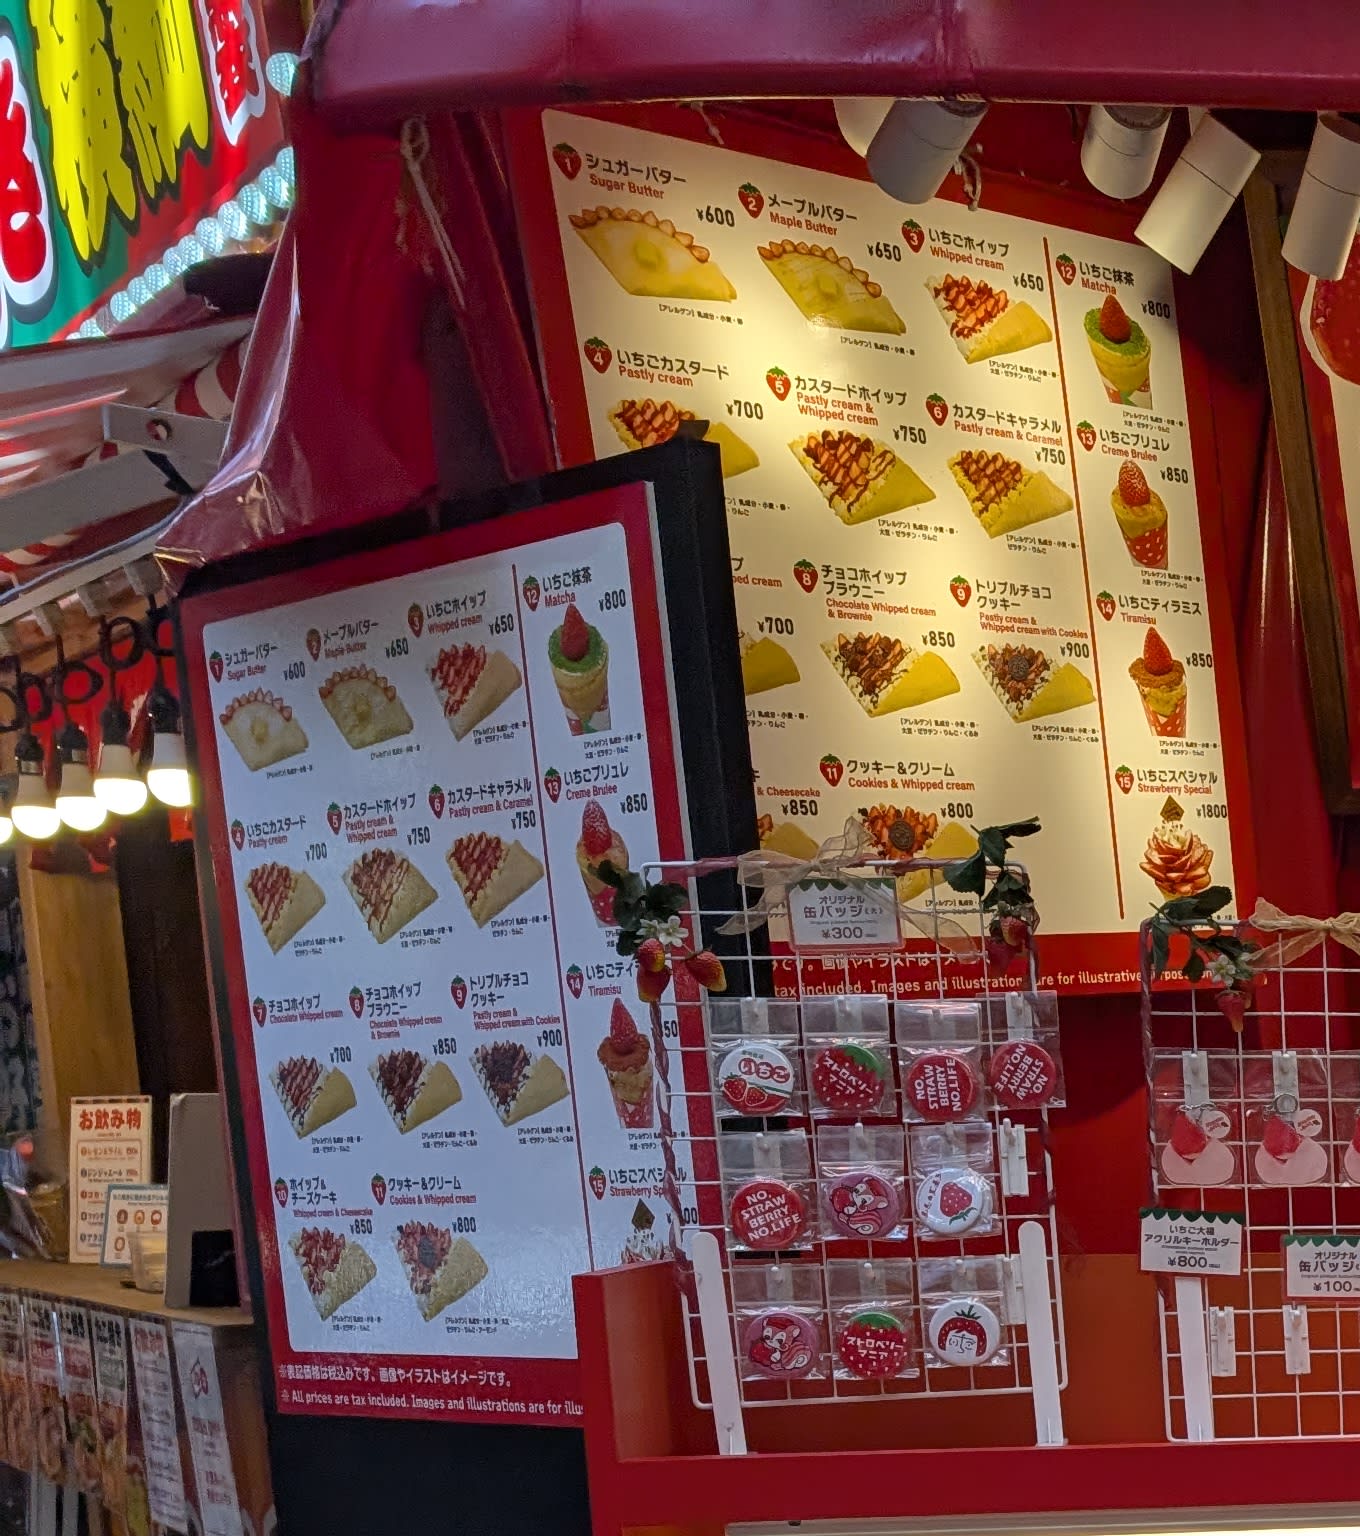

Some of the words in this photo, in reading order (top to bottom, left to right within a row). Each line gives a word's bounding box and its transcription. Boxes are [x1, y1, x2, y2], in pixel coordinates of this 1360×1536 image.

[586, 153, 686, 184] シュガーバター
[589, 173, 625, 191] Sugar
[627, 181, 664, 199] Butter
[697, 207, 735, 227] ¥600
[768, 194, 858, 223] メープルバター
[868, 242, 902, 262] ¥650
[929, 229, 1009, 257] いちごホイップ
[930, 246, 973, 266] Whipped
[975, 256, 1004, 271] cream
[1079, 261, 1134, 286] いちご抹茶
[1081, 278, 1116, 295] Matcha
[1142, 301, 1170, 319] ¥800
[617, 349, 729, 380] いちごカスタード
[795, 375, 907, 406] カスタードホイップ
[726, 399, 763, 419] ¥700
[1100, 429, 1170, 451] いちごブリュレ
[1101, 446, 1128, 459] Creme
[1131, 449, 1158, 462] Brulee
[1160, 466, 1188, 484] ¥850
[542, 567, 592, 590] いちご抹茶
[976, 581, 1051, 599] トリプルチョコ
[426, 591, 487, 619] いちごホイップ
[599, 590, 626, 611] ¥800
[1119, 594, 1201, 615] いちごティラミス
[1121, 613, 1156, 625] Tiramisu
[225, 644, 278, 668] シュガーバター
[283, 663, 305, 680] ¥600
[564, 762, 629, 785] いちごブリュレ
[847, 759, 955, 776] クッキー&クリーム
[1137, 768, 1217, 785] いちごスペシャル
[447, 777, 531, 800] カスタードキャラメル
[1138, 784, 1180, 796] Strawberry
[1183, 784, 1212, 796] Special
[1196, 804, 1228, 819] ¥1800
[819, 895, 865, 904] オリジナル
[822, 927, 862, 939] ¥300
[537, 1030, 562, 1047] ¥900
[739, 1057, 790, 1084] いちご
[823, 1056, 873, 1094] ストロベリー
[829, 1074, 855, 1094] マニア
[79, 1107, 142, 1130] お飲み物
[741, 1194, 786, 1220] STRAW
[749, 1207, 789, 1228] BERRY
[1144, 1233, 1239, 1247] アクリルキーホルダー
[1167, 1256, 1208, 1268] ¥800
[1313, 1281, 1352, 1292] ¥100
